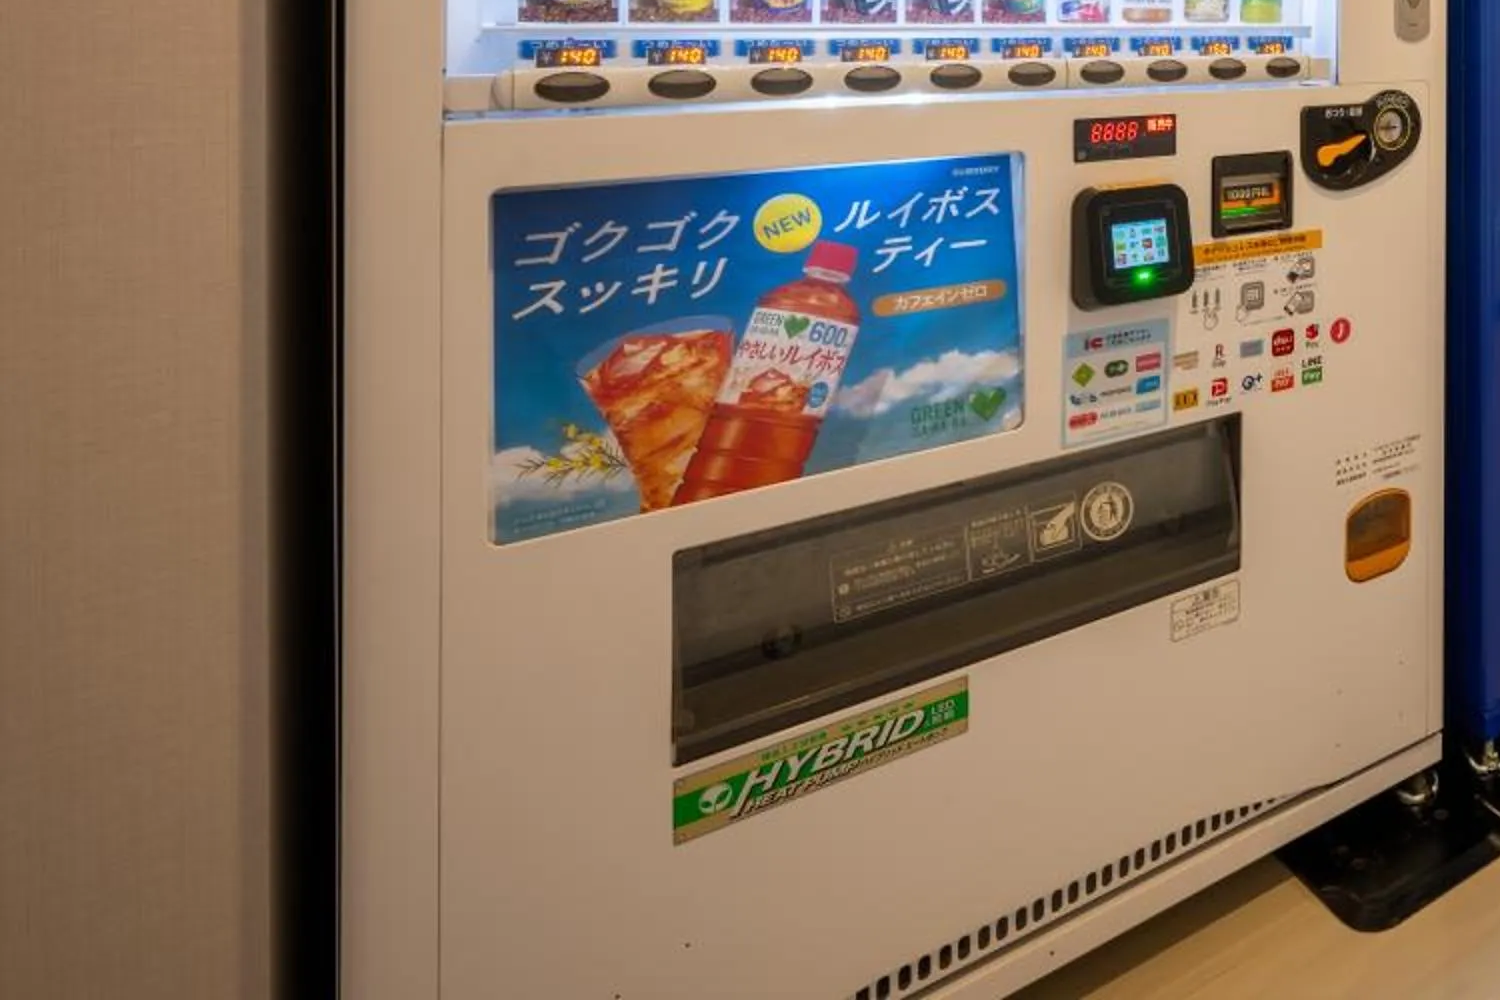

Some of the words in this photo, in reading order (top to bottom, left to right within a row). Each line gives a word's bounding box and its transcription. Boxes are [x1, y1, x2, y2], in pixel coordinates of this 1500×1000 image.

[560, 48, 597, 65] 140
[670, 47, 702, 63] 140
[768, 47, 800, 62] 140
[857, 47, 889, 61] 140
[940, 46, 967, 60] 140
[834, 186, 1000, 233] ルイボス
[763, 207, 812, 240] NEW
[514, 209, 740, 267] ゴクゴク
[872, 236, 988, 273] ティー
[512, 257, 728, 320] スッキリ
[894, 284, 989, 311] カフェインゼロ
[808, 321, 847, 346] 600
[729, 710, 926, 818] HYBRID
